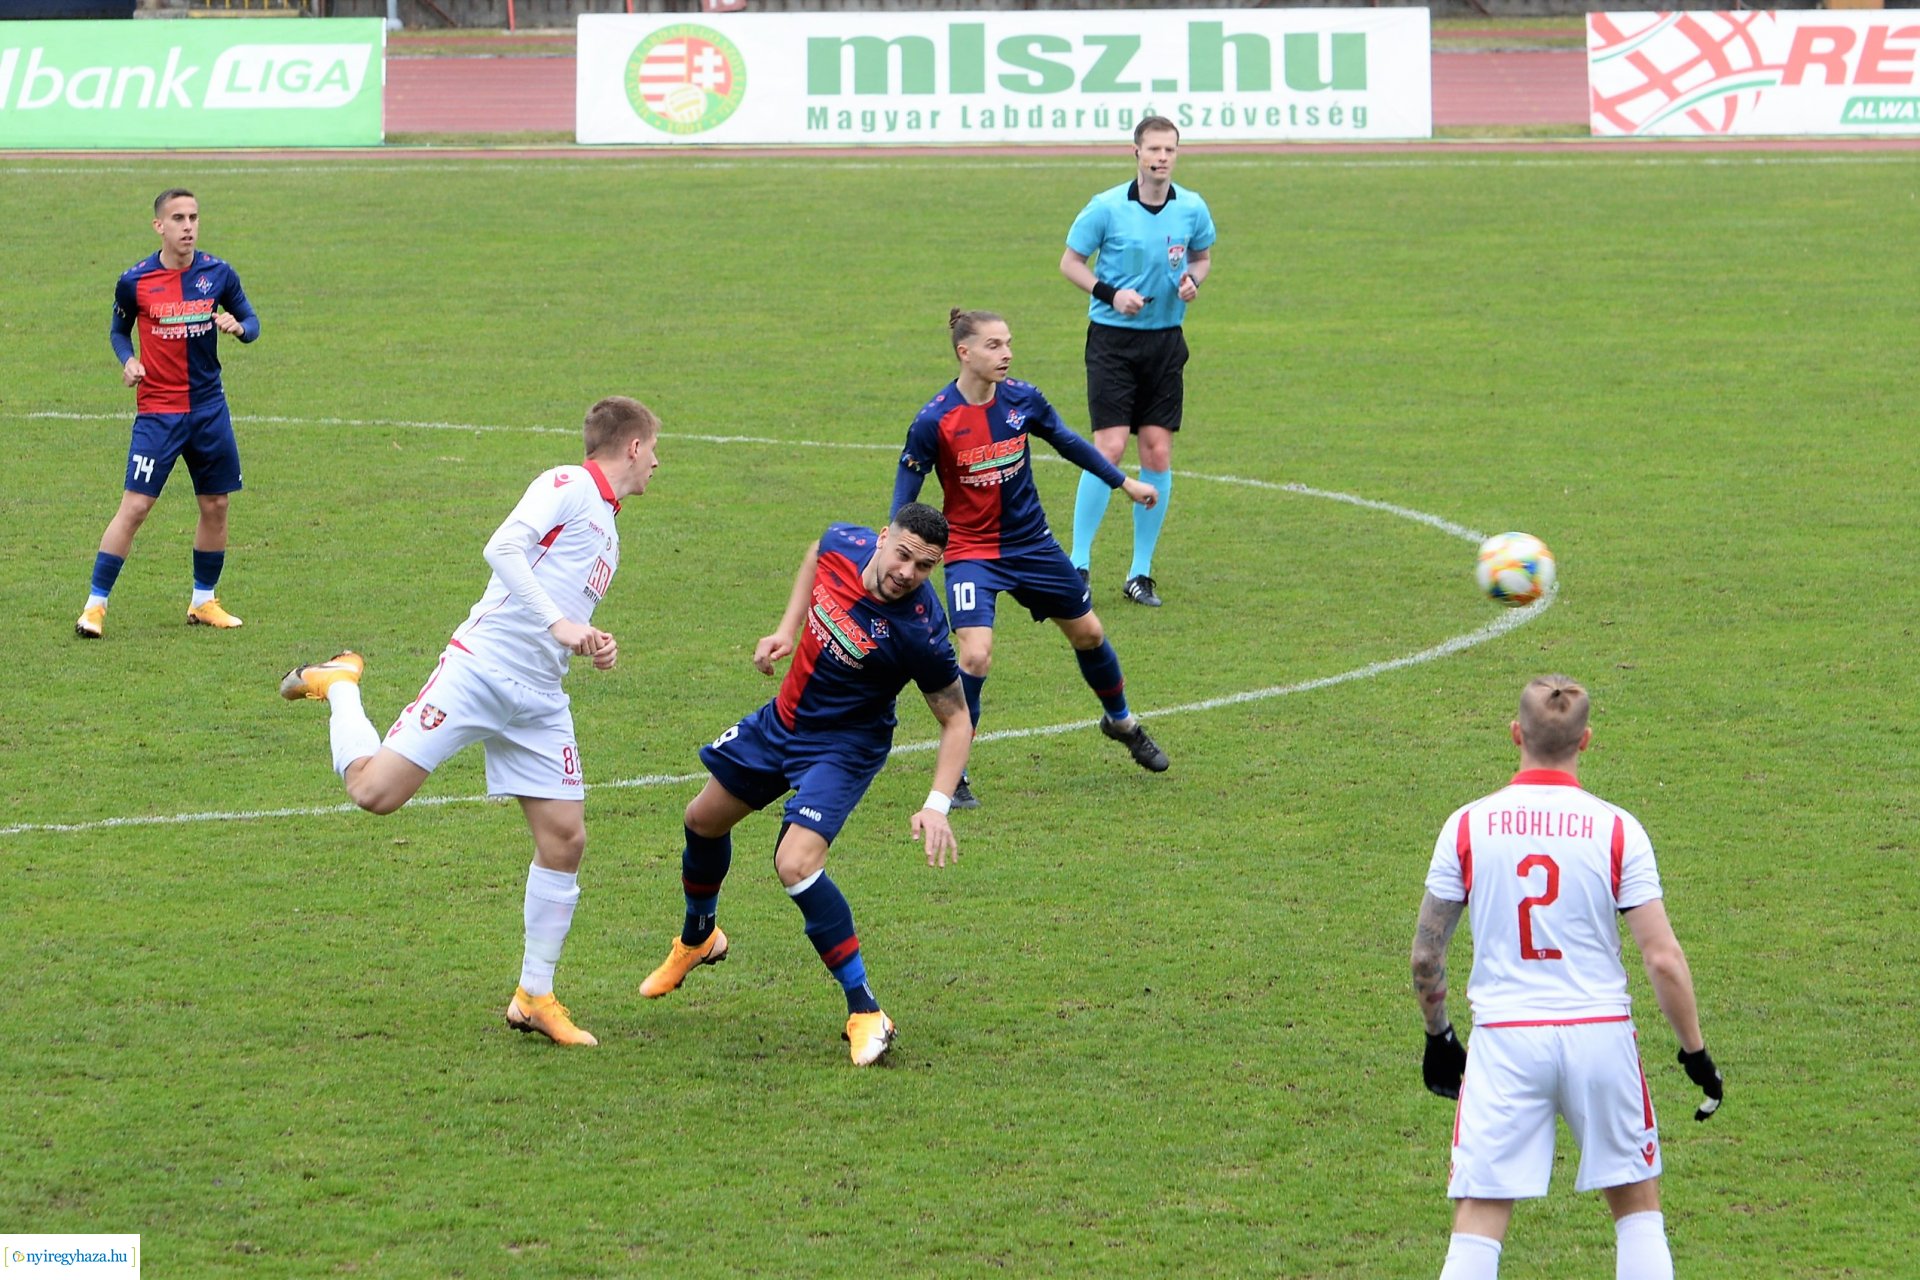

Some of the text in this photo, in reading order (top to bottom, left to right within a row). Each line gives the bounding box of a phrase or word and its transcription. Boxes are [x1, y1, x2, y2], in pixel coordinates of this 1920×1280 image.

[807, 21, 1367, 95] mlsz.hu
[224, 59, 351, 94] LIGA
[807, 105, 940, 132] Magyar
[1178, 101, 1368, 129] Szövetség
[1847, 101, 1920, 120] ALWA
[150, 299, 215, 318] REVESZ
[957, 432, 1028, 466] REVESZ
[132, 454, 155, 483] 74
[952, 581, 976, 612] 10
[813, 583, 878, 655] REVESZ
[799, 806, 822, 822] JAKO
[1488, 806, 1593, 839] FRÖHLICH
[1517, 854, 1562, 960] 2
